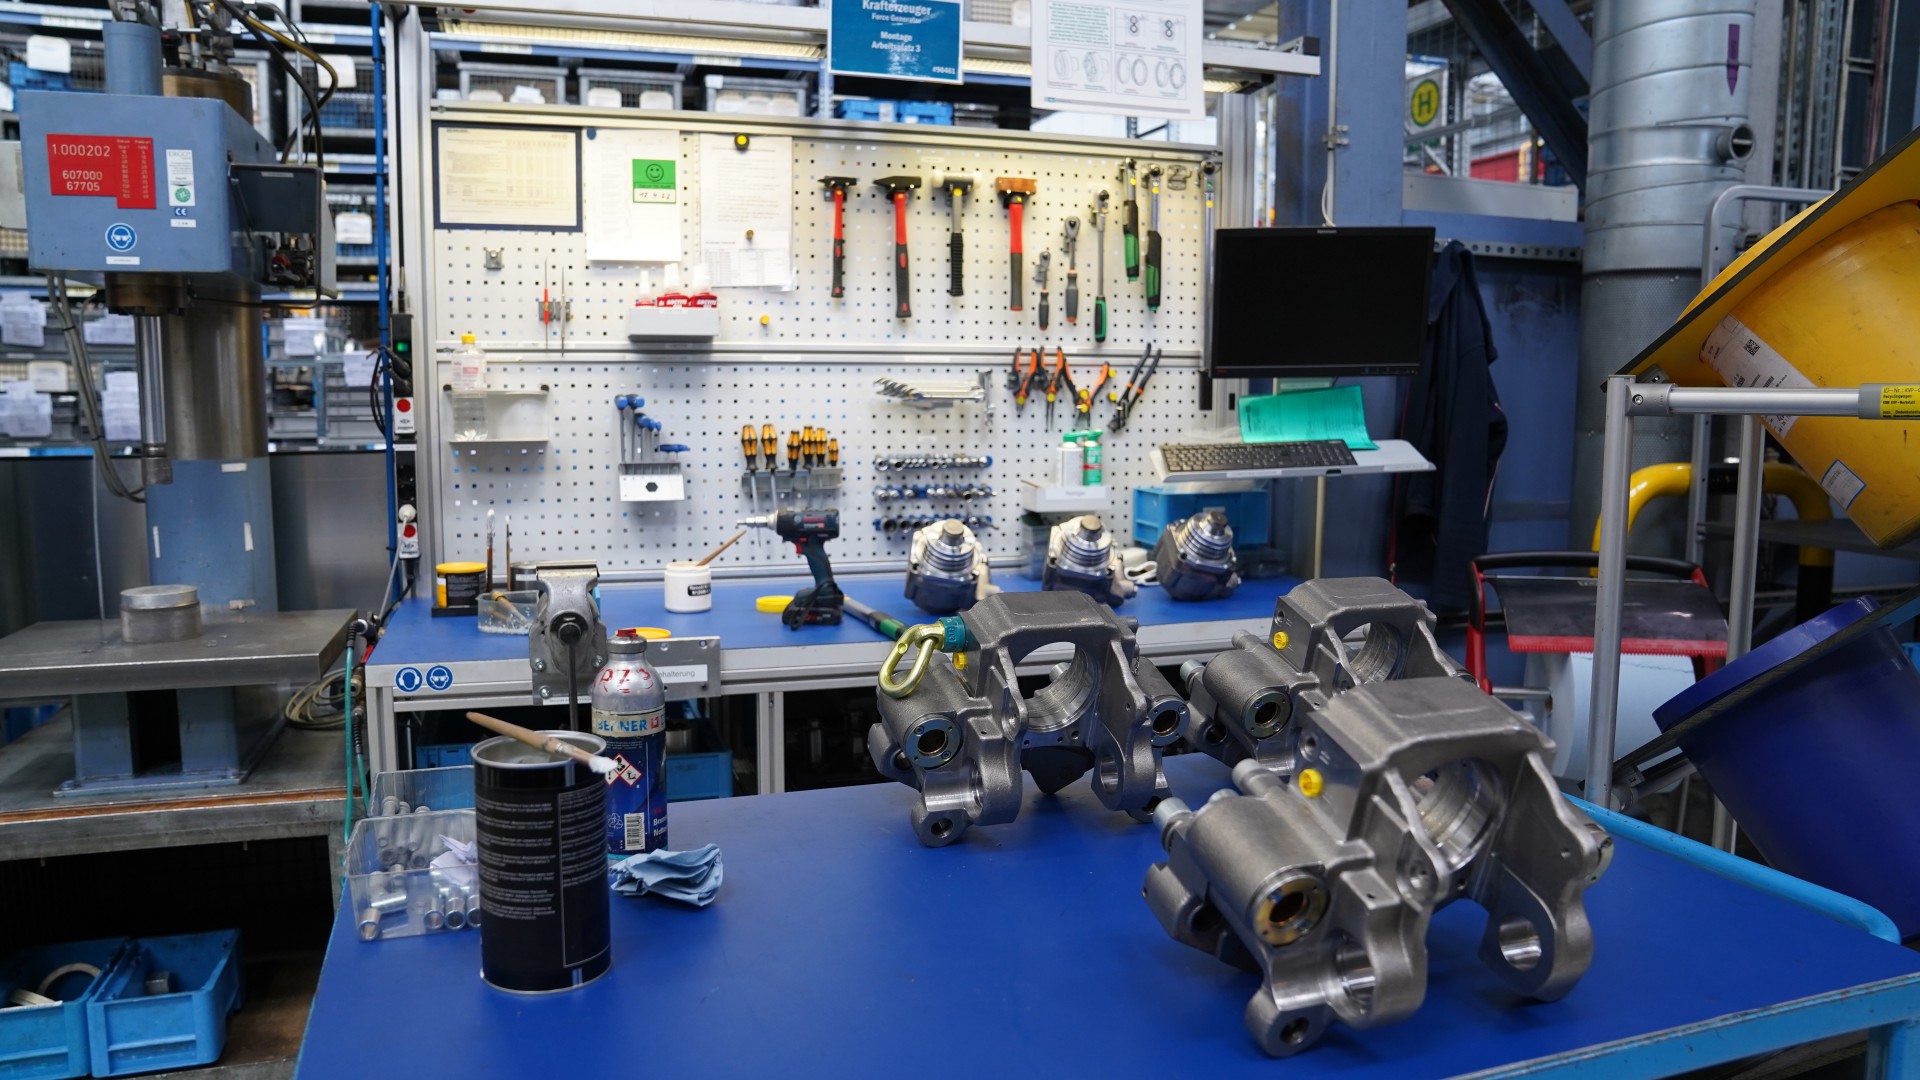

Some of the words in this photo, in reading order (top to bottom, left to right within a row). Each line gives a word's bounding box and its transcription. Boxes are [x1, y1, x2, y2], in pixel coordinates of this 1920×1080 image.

[862, 0, 932, 16] Krafterzeuger
[871, 13, 890, 21] Force
[880, 31, 913, 42] Montage
[871, 41, 914, 53] Arbeitsplatz
[1418, 90, 1433, 117] H
[52, 144, 111, 157] 1.000202
[62, 170, 103, 181] 607000
[66, 181, 100, 191] 67705
